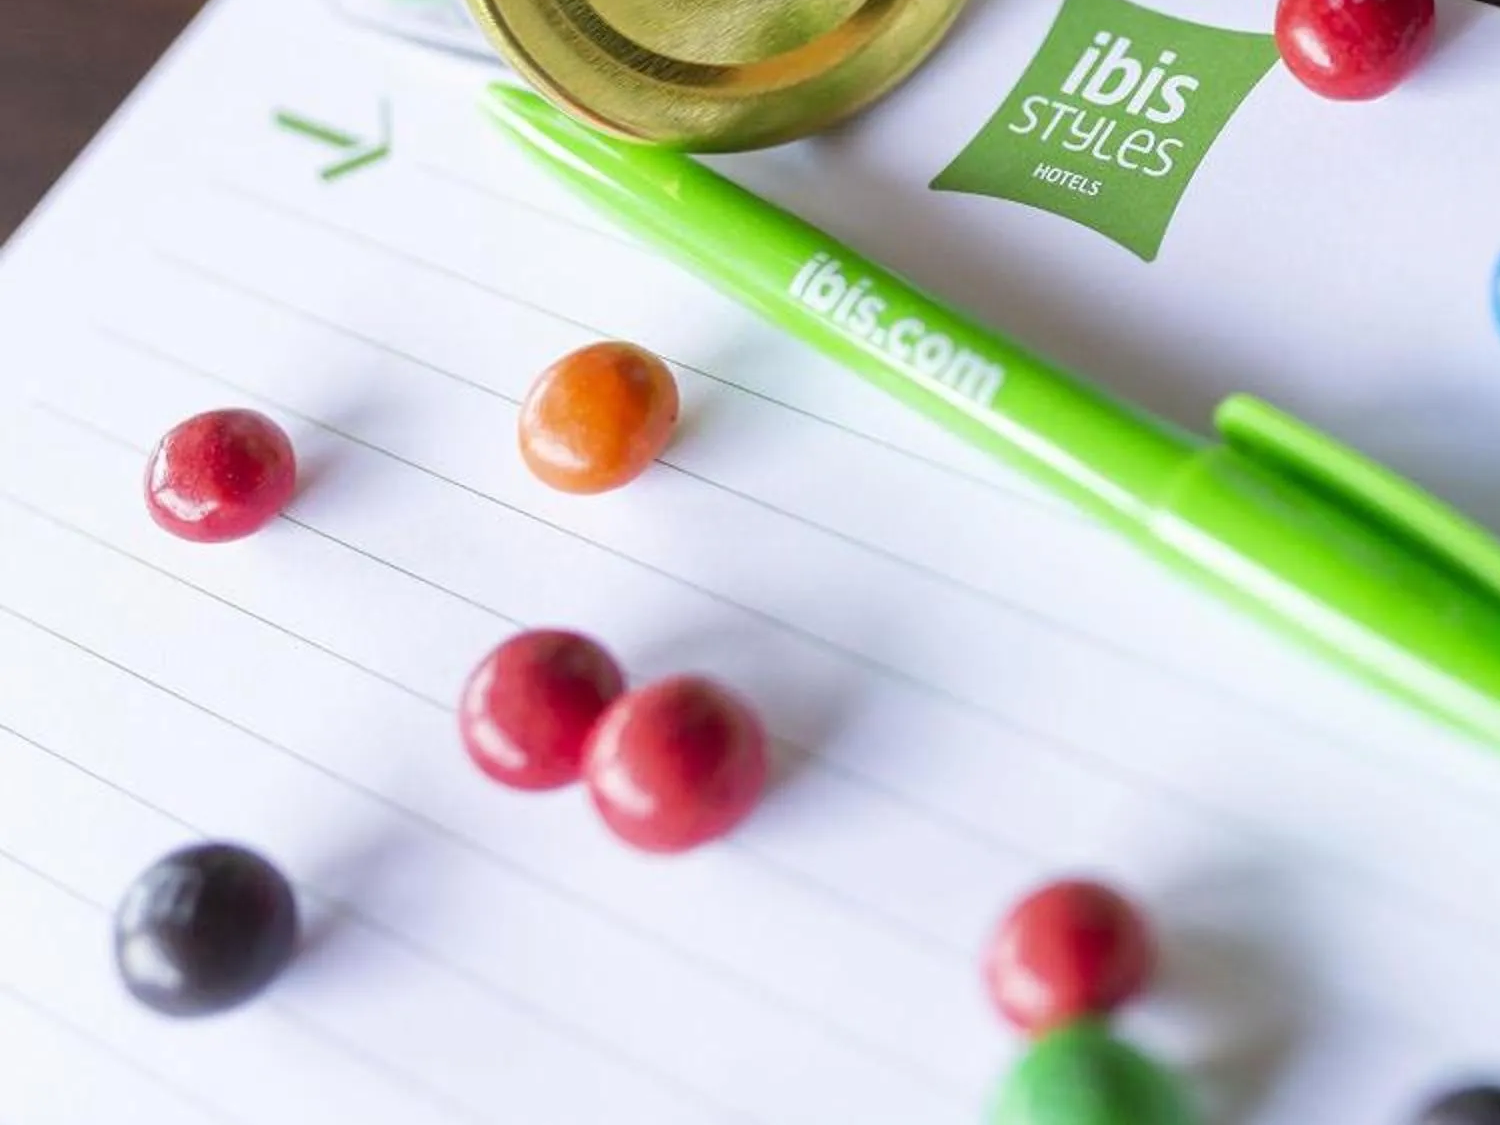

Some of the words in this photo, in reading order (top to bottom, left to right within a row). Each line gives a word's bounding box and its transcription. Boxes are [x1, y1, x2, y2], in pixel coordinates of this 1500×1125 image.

[1060, 30, 1200, 125] ibis
[1032, 161, 1103, 197] HOTELS
[789, 251, 1005, 409] ibis.com
